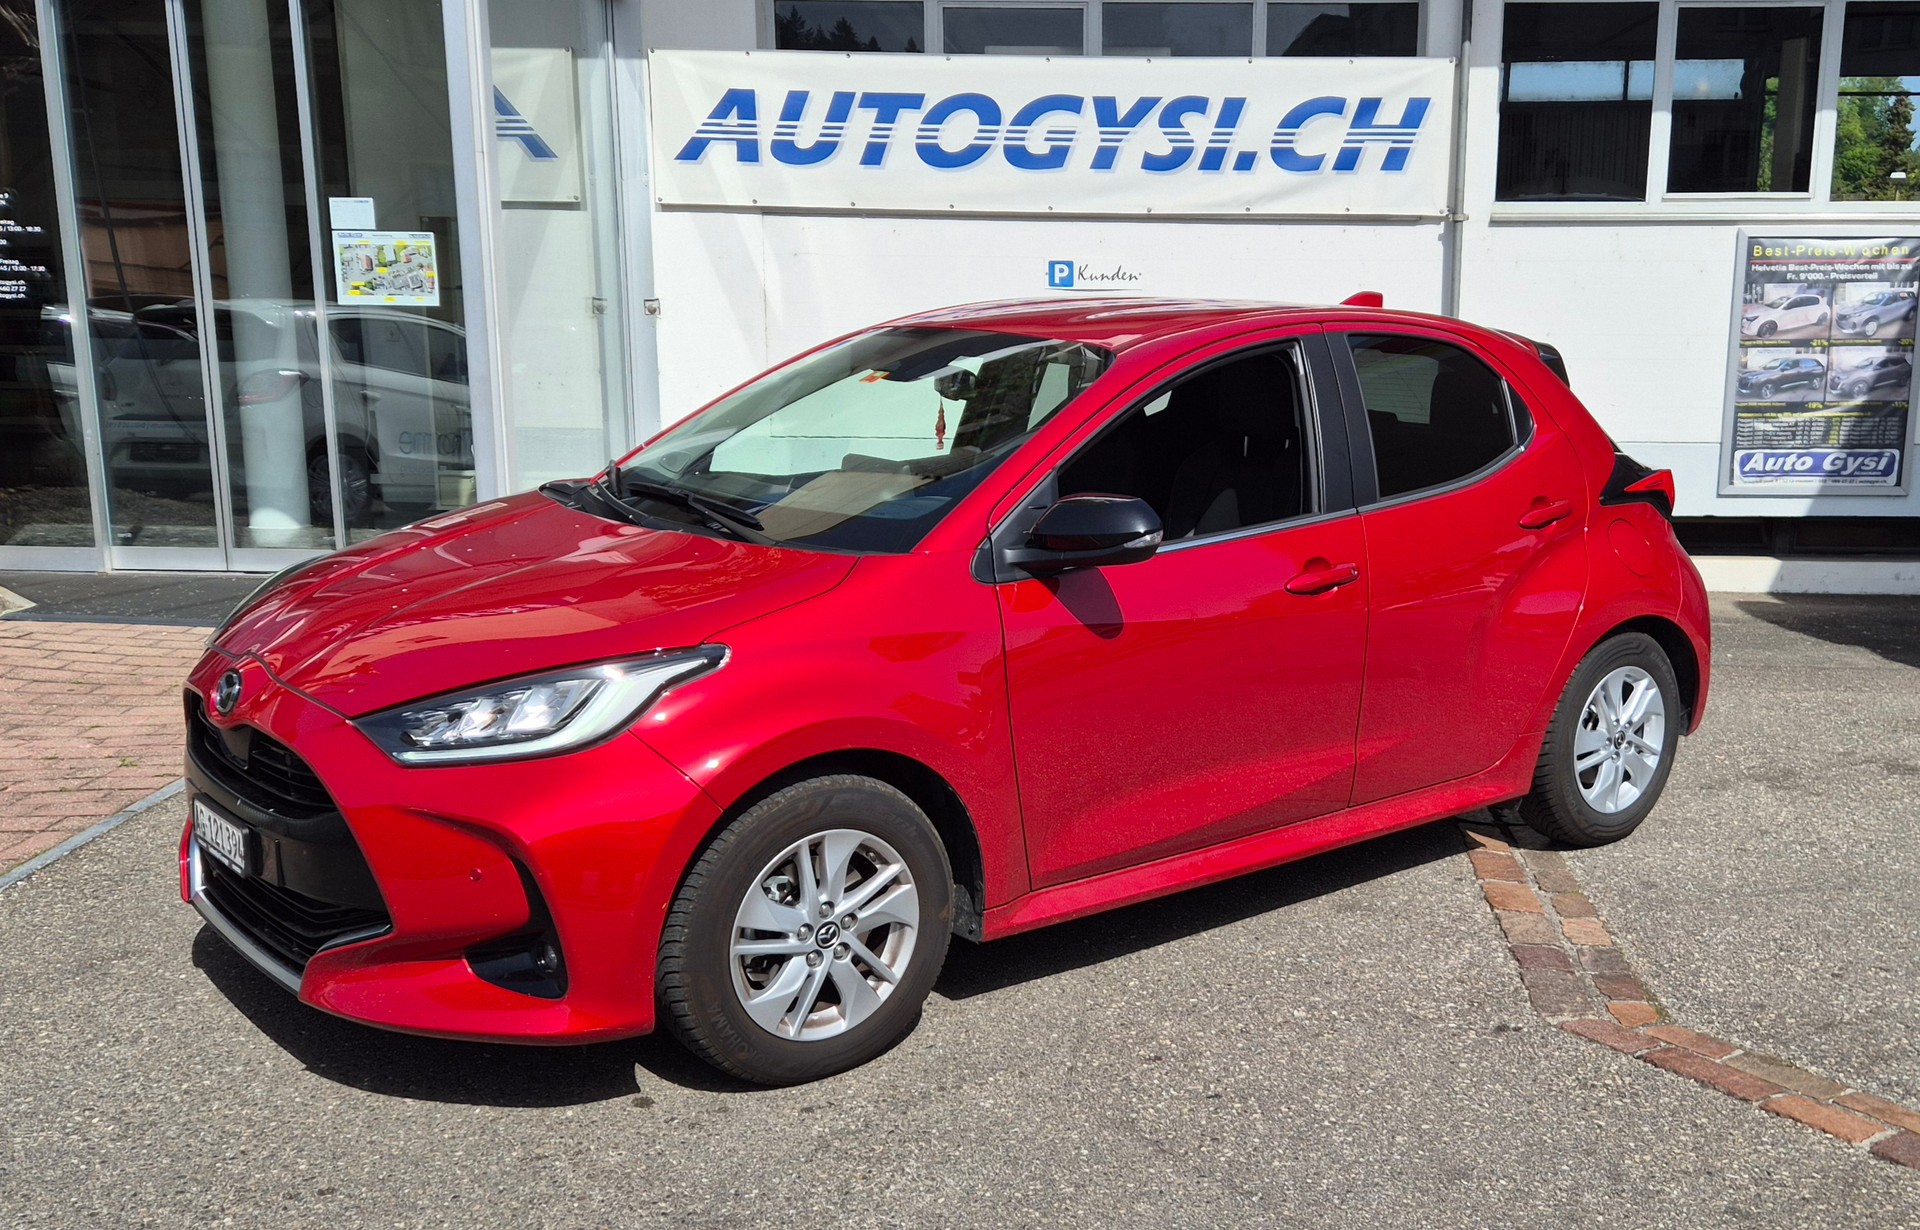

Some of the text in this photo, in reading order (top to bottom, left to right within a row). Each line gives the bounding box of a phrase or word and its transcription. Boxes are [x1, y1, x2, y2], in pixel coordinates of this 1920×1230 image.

[675, 86, 1431, 174] AUTOGYSI.CH
[1077, 263, 1139, 281] Kunden
[1743, 452, 1892, 475] Auto Gysi
